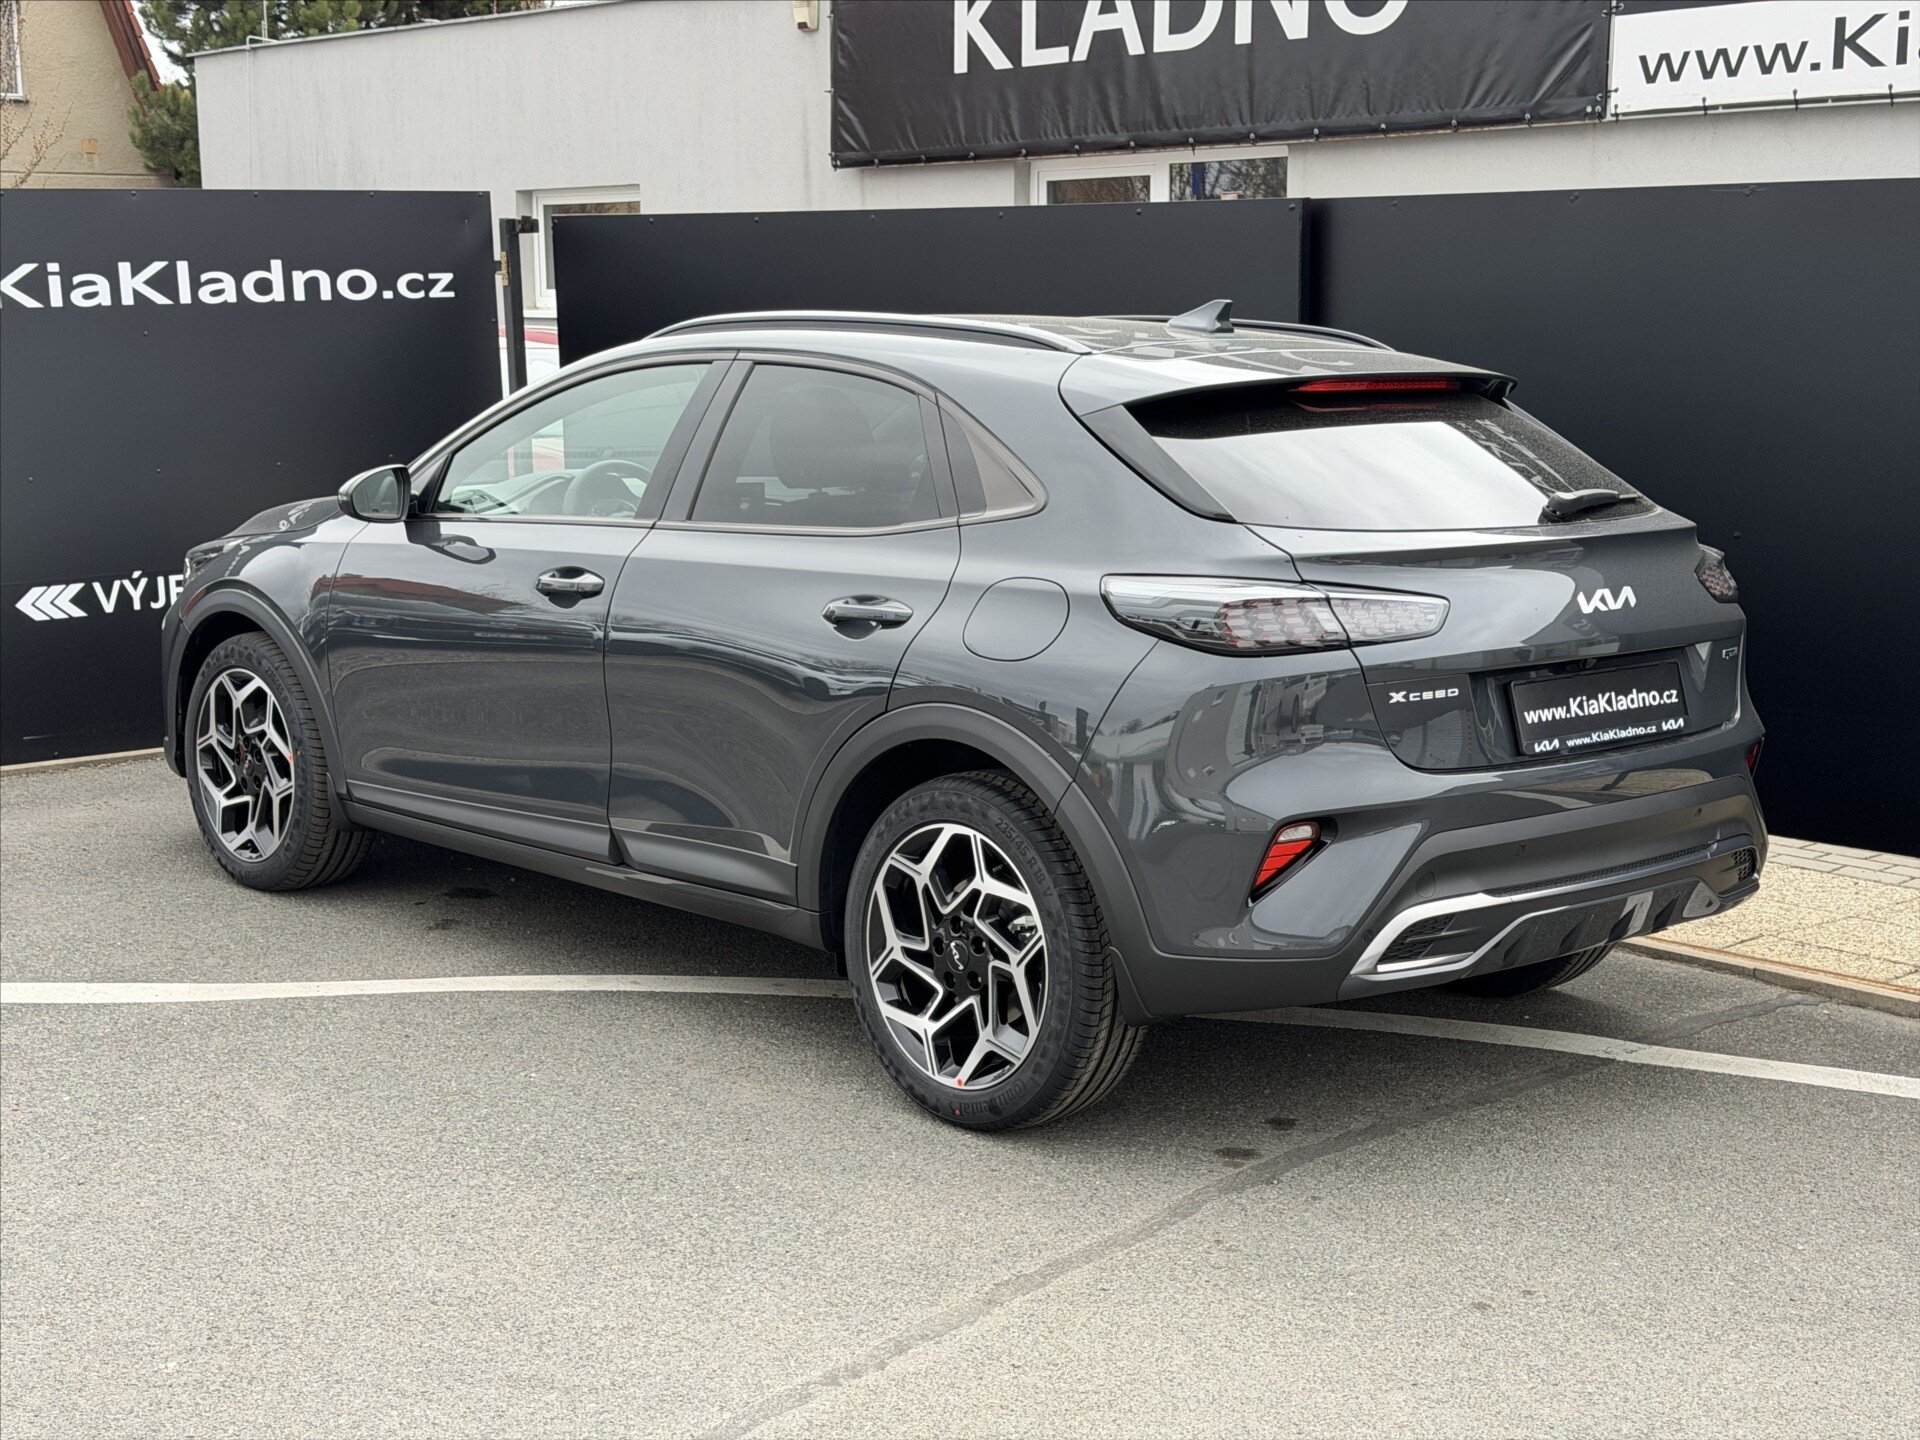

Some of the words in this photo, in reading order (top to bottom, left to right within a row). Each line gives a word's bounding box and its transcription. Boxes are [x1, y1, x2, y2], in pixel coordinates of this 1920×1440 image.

[1638, 10, 1920, 84] www.Ki
[1577, 585, 1637, 614] KIA
[1388, 687, 1460, 704] XCEED
[1523, 688, 1679, 725] www.KiaKladno.cz
[1534, 738, 1559, 753] KIA
[1565, 724, 1657, 747] www.KiaKladno.cz
[1661, 717, 1685, 731] KIA
